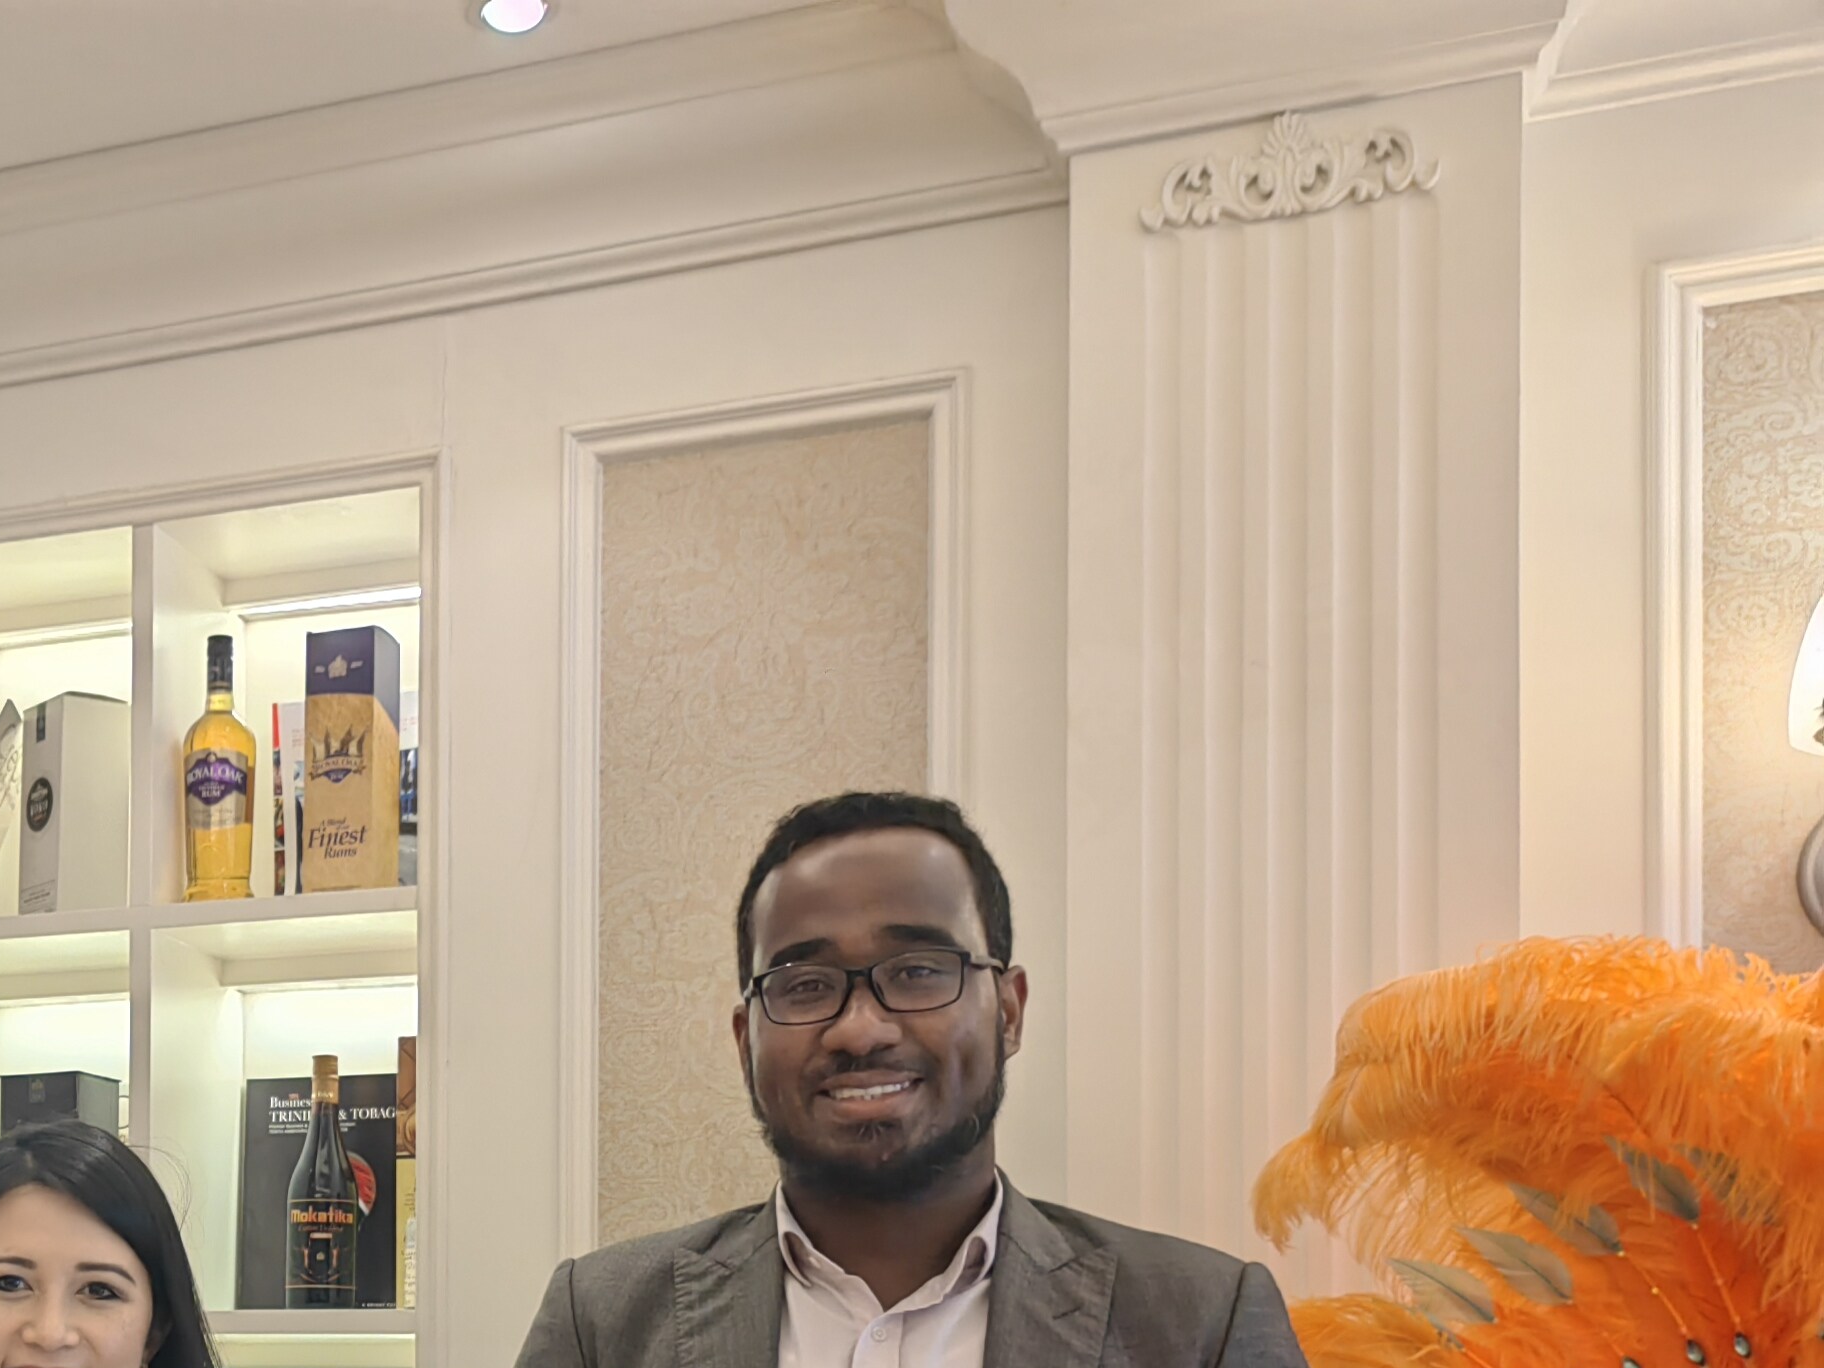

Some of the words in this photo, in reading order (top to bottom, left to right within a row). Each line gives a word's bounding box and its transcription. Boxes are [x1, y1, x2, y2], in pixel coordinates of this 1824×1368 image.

[186, 766, 214, 785] ROYAL
[217, 764, 244, 784] OAK
[308, 826, 367, 848] Finest
[338, 1111, 347, 1121] &
